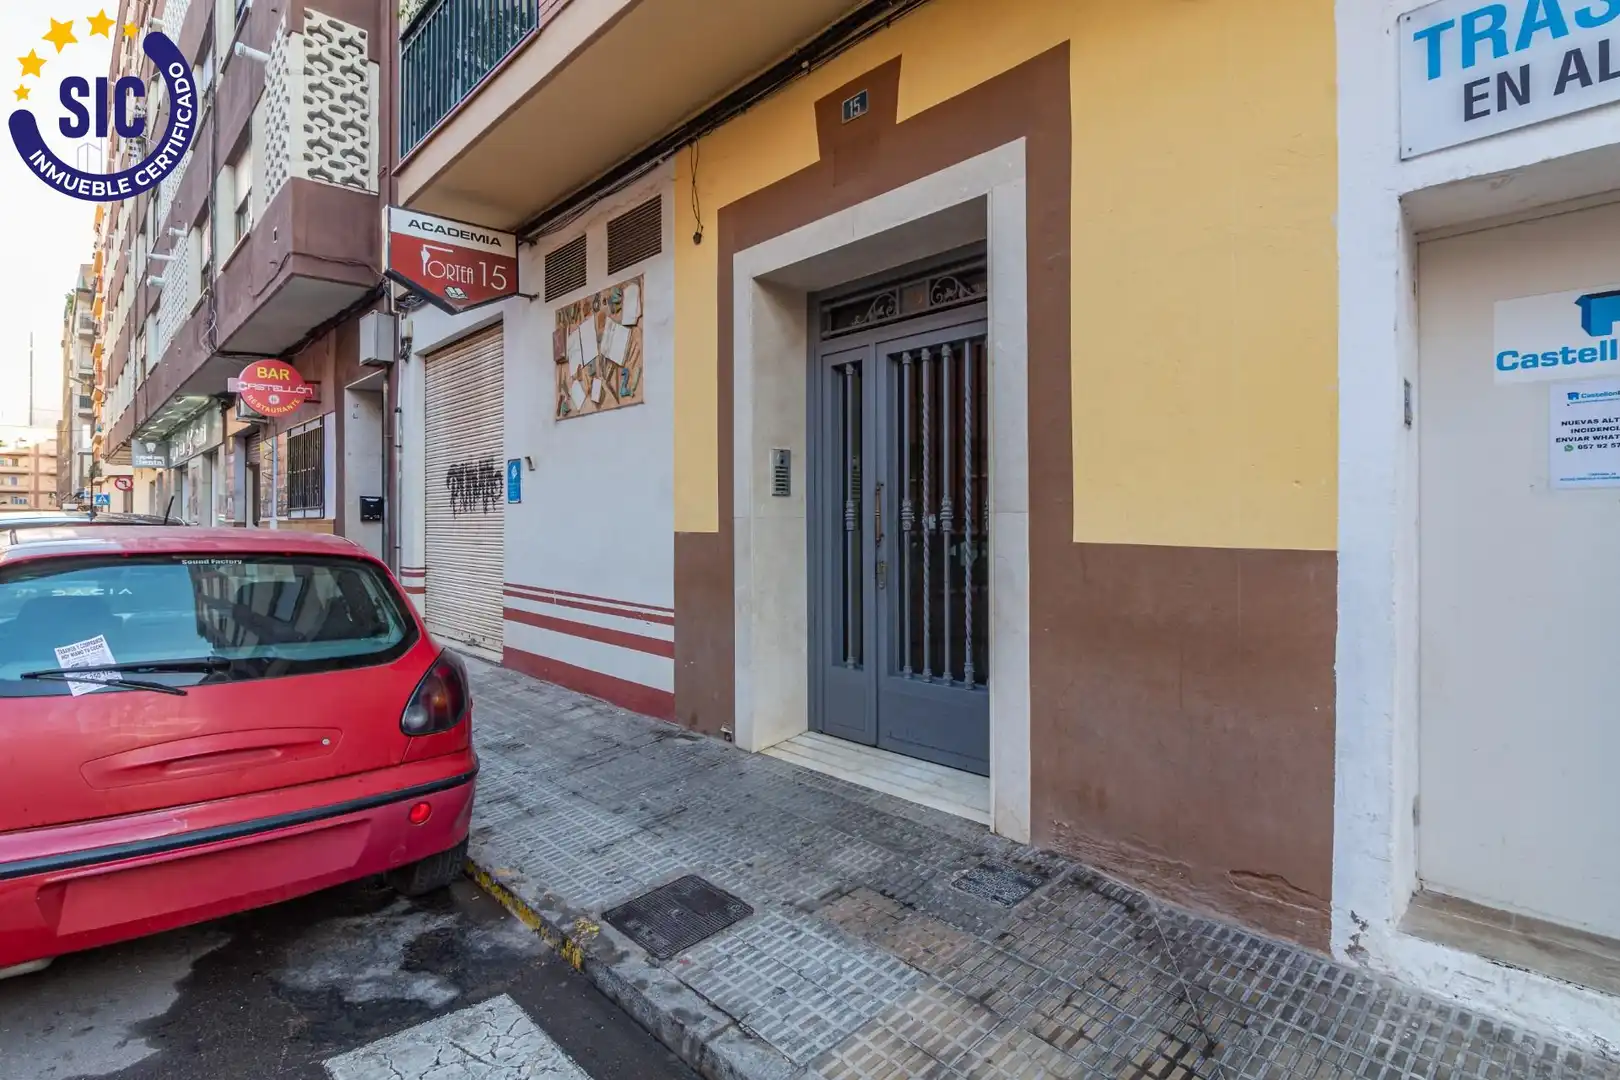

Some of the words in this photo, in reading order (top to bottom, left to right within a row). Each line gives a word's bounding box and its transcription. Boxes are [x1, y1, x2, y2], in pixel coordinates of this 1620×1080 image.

[1463, 63, 1531, 122] EN
[1553, 38, 1620, 96] AL
[849, 96, 861, 117] 15
[407, 219, 502, 247] ACADEMIA
[478, 261, 507, 291] 15
[1496, 338, 1618, 371] Castell
[256, 366, 290, 380] BAR
[247, 394, 301, 413] RESTAURANTE
[1561, 418, 1599, 427] NUEVAS
[1555, 435, 1590, 443] ENVIAR
[210, 558, 243, 566] Factory
[52, 587, 133, 597] DACIA
